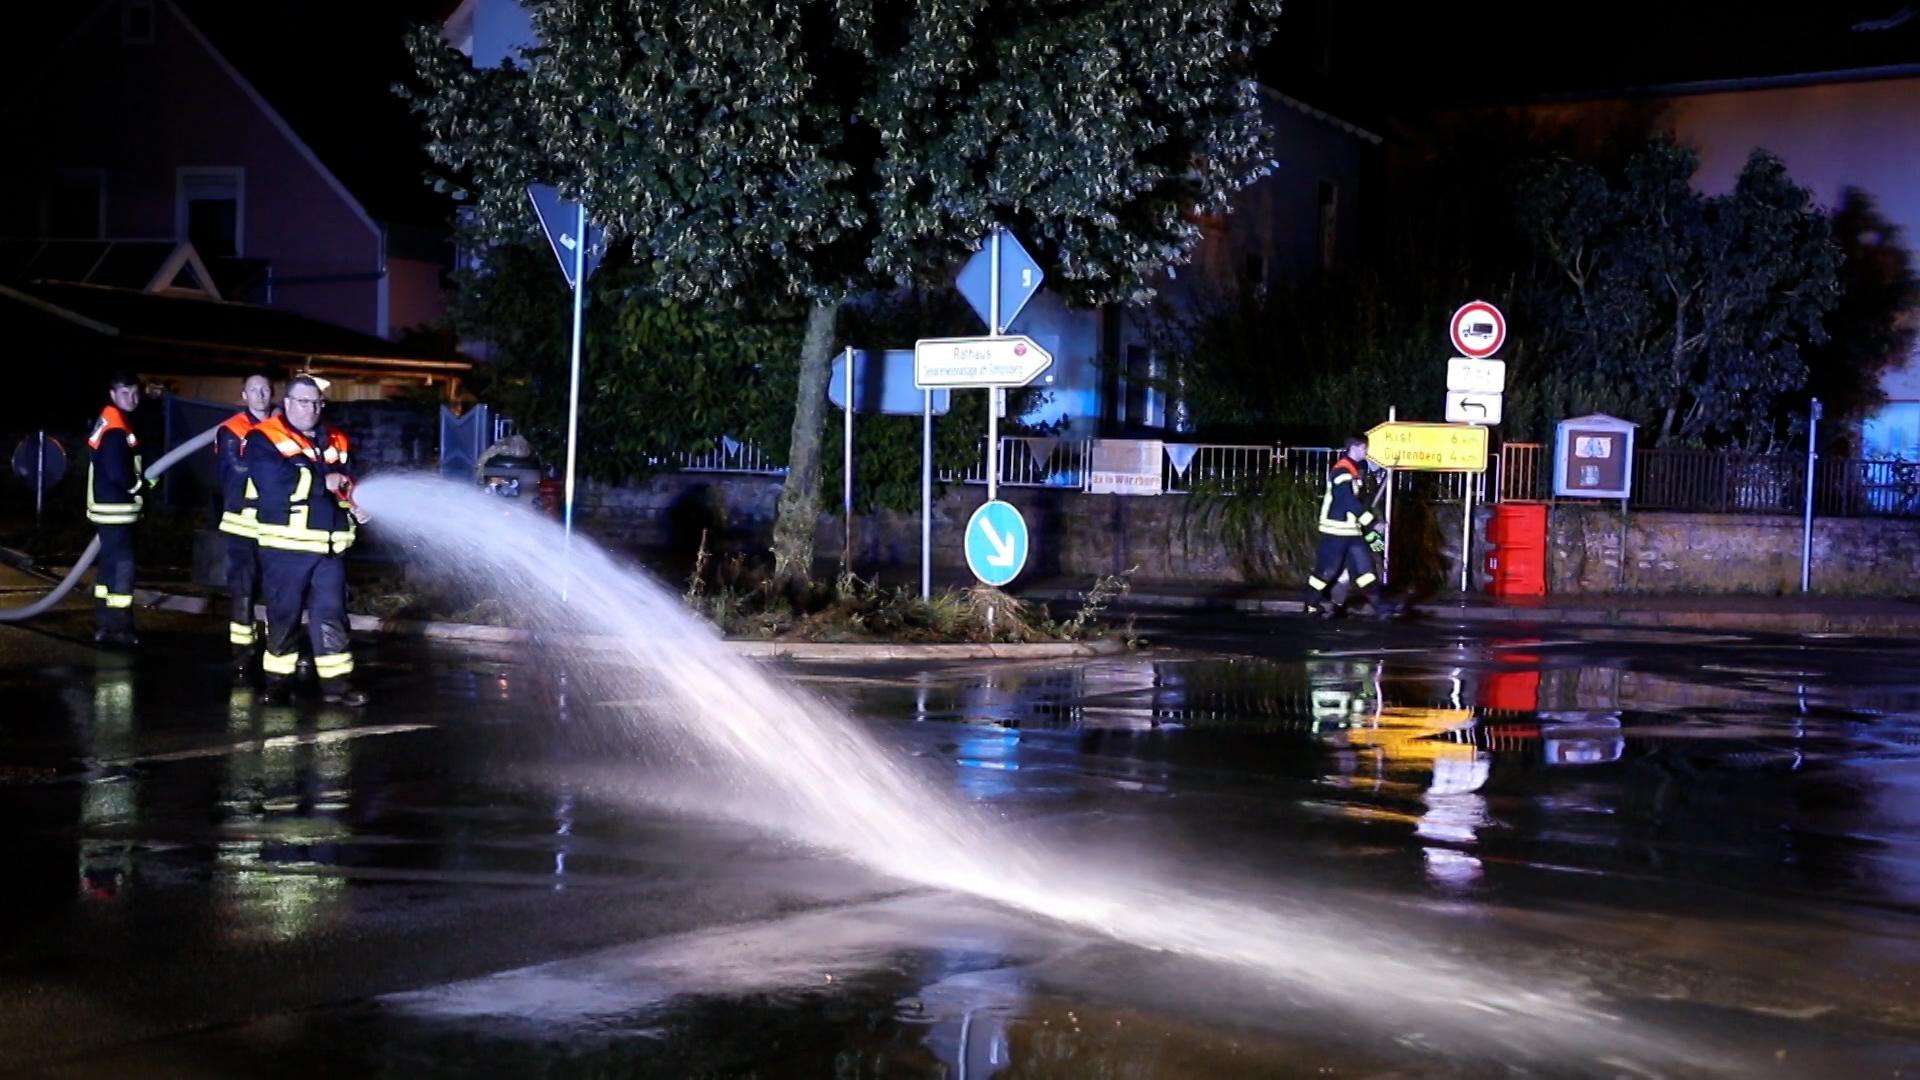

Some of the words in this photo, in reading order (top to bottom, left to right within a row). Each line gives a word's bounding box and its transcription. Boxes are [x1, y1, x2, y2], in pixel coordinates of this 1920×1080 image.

[953, 347, 992, 360] Rathaus
[1385, 431, 1412, 442] Kist
[1451, 433, 1458, 444] 6
